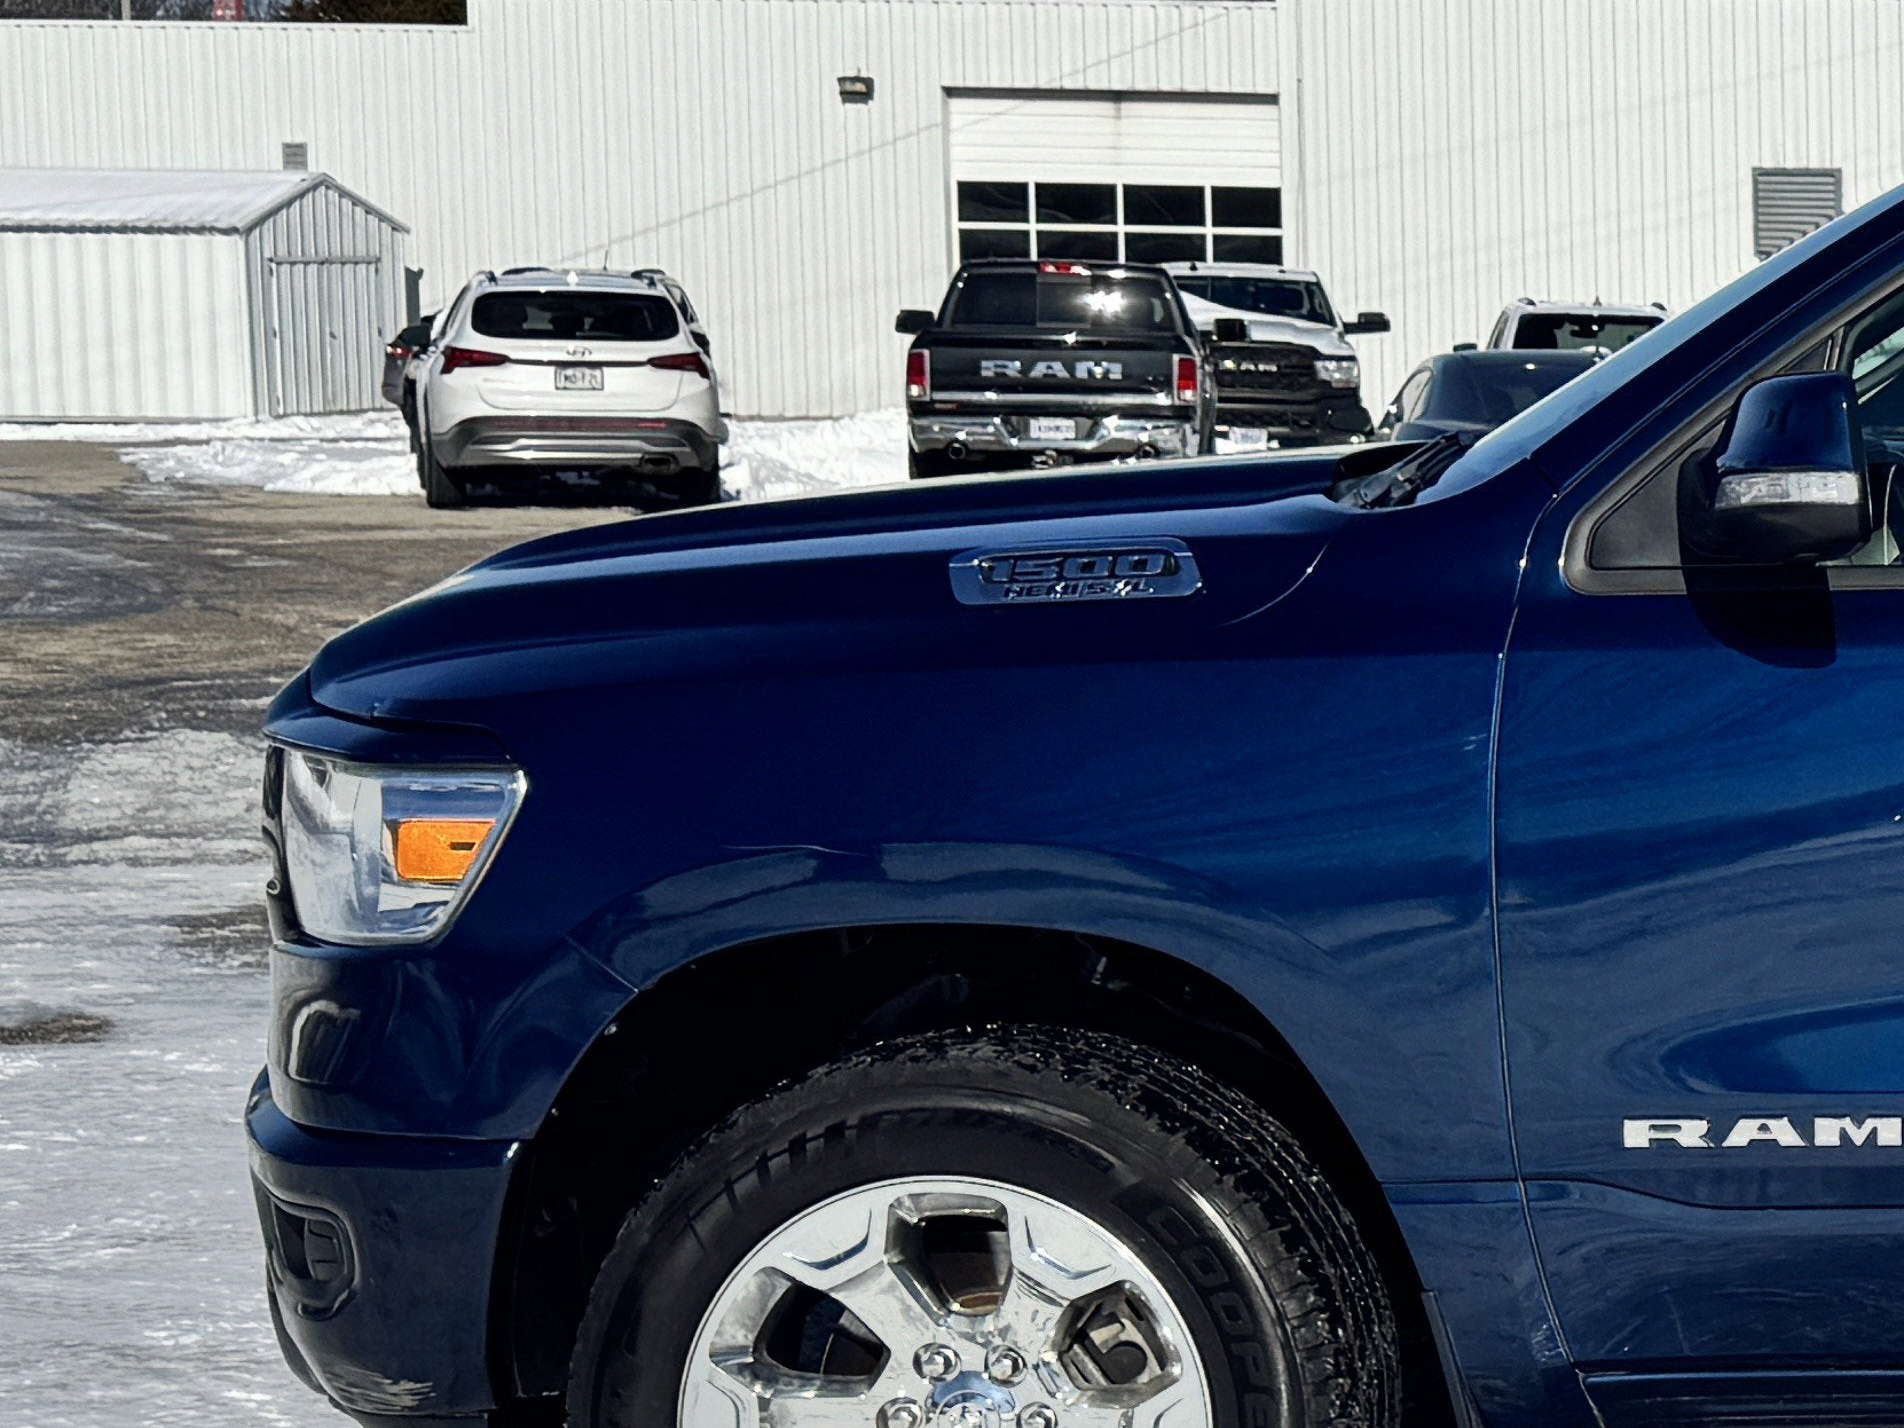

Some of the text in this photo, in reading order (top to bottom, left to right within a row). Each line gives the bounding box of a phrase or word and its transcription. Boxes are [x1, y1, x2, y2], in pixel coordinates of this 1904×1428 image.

[980, 359, 1123, 380] RAM
[976, 553, 1166, 582] 1500
[1622, 1116, 1903, 1148] RAM
